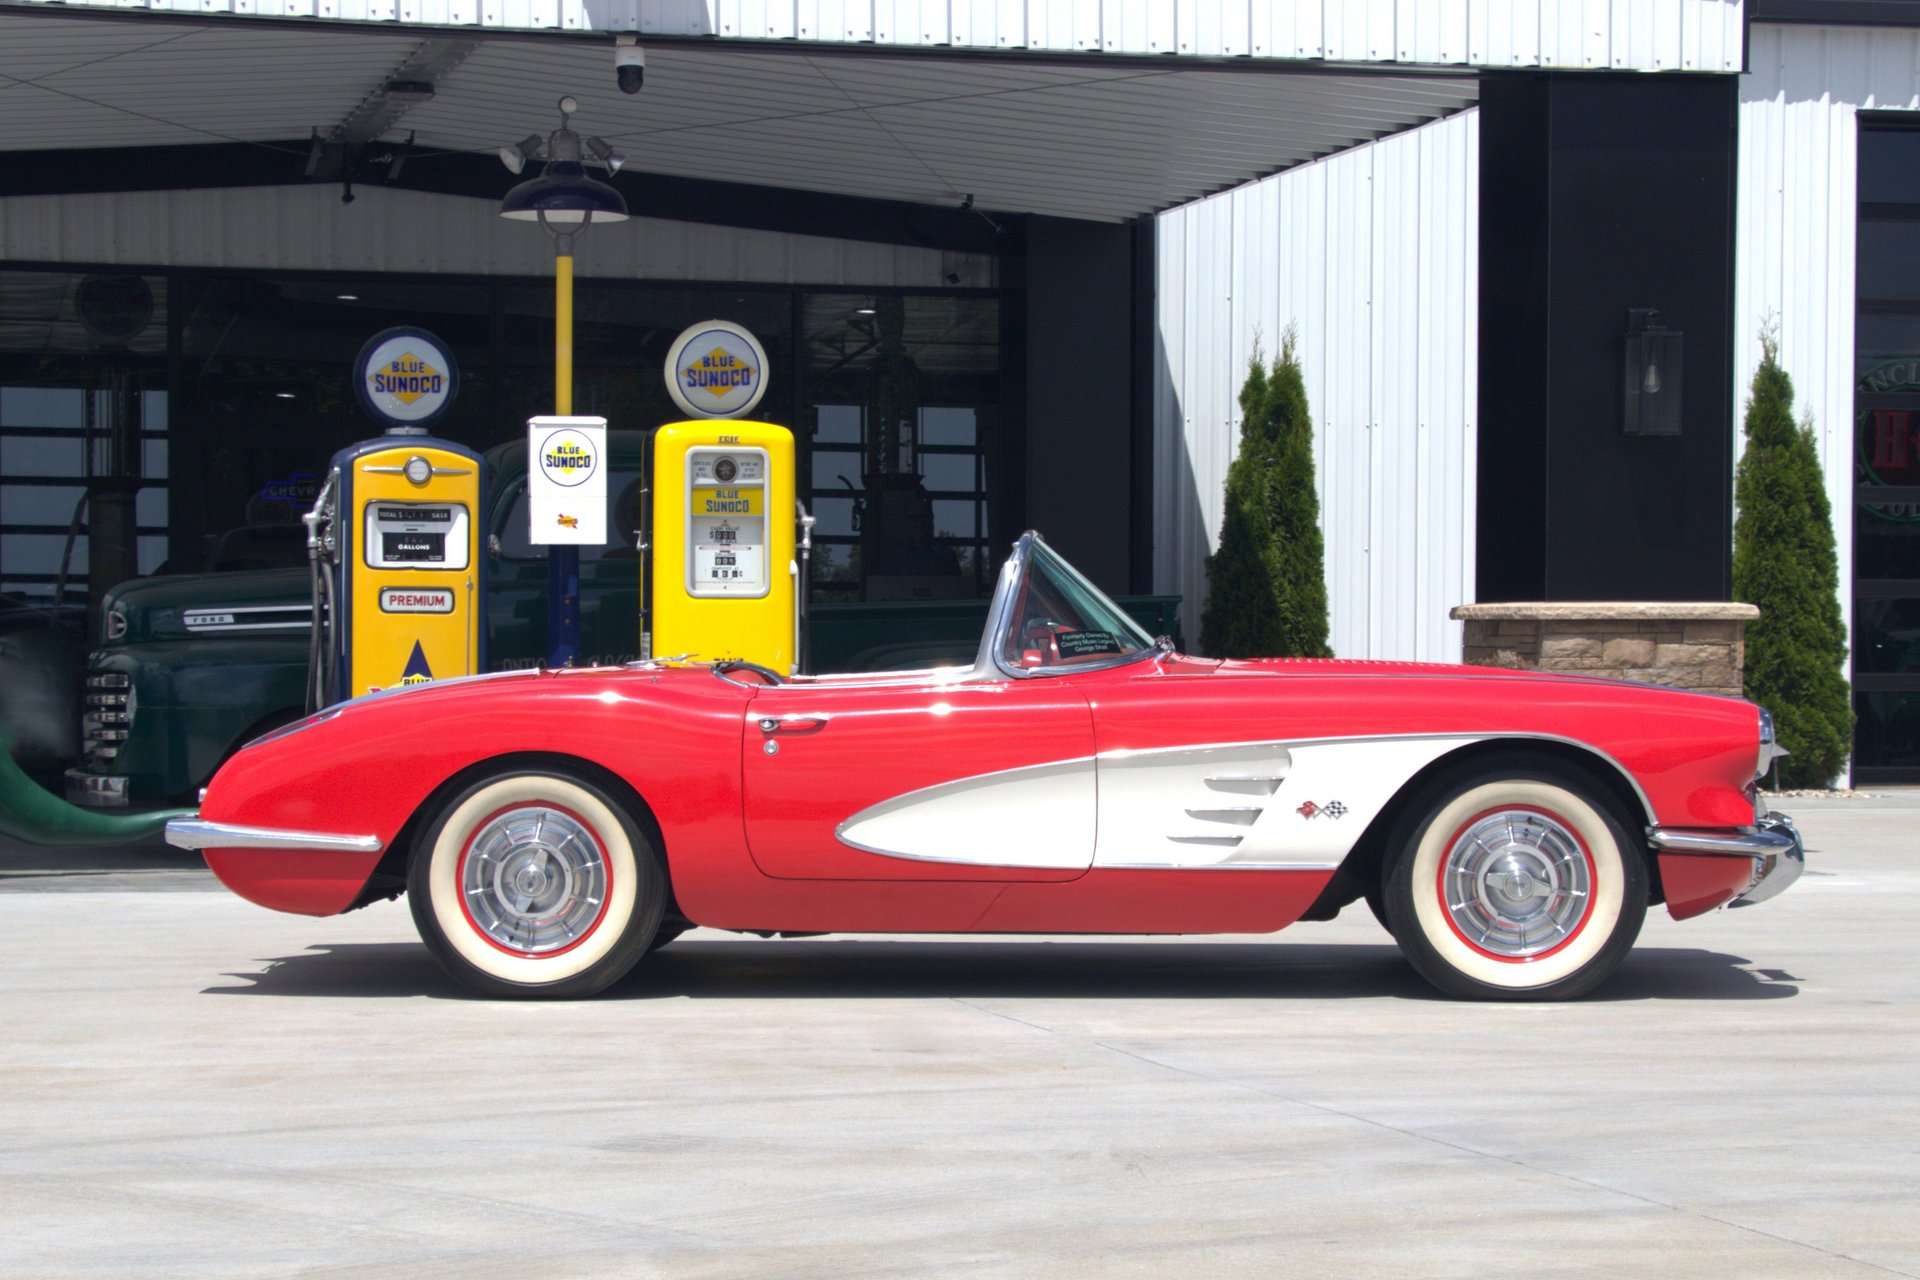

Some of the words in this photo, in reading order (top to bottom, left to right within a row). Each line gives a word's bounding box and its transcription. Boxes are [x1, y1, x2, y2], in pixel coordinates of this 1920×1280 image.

[391, 361, 425, 373] BLUE
[702, 355, 736, 368] BLUE
[375, 374, 441, 393] SUNOCO
[687, 367, 751, 387] SUNOCO
[557, 446, 580, 454] BLUE
[546, 455, 591, 468] SUNOCO
[715, 489, 739, 499] BLUE
[705, 499, 750, 513] SUNOCO
[388, 594, 446, 607] PREMIUM
